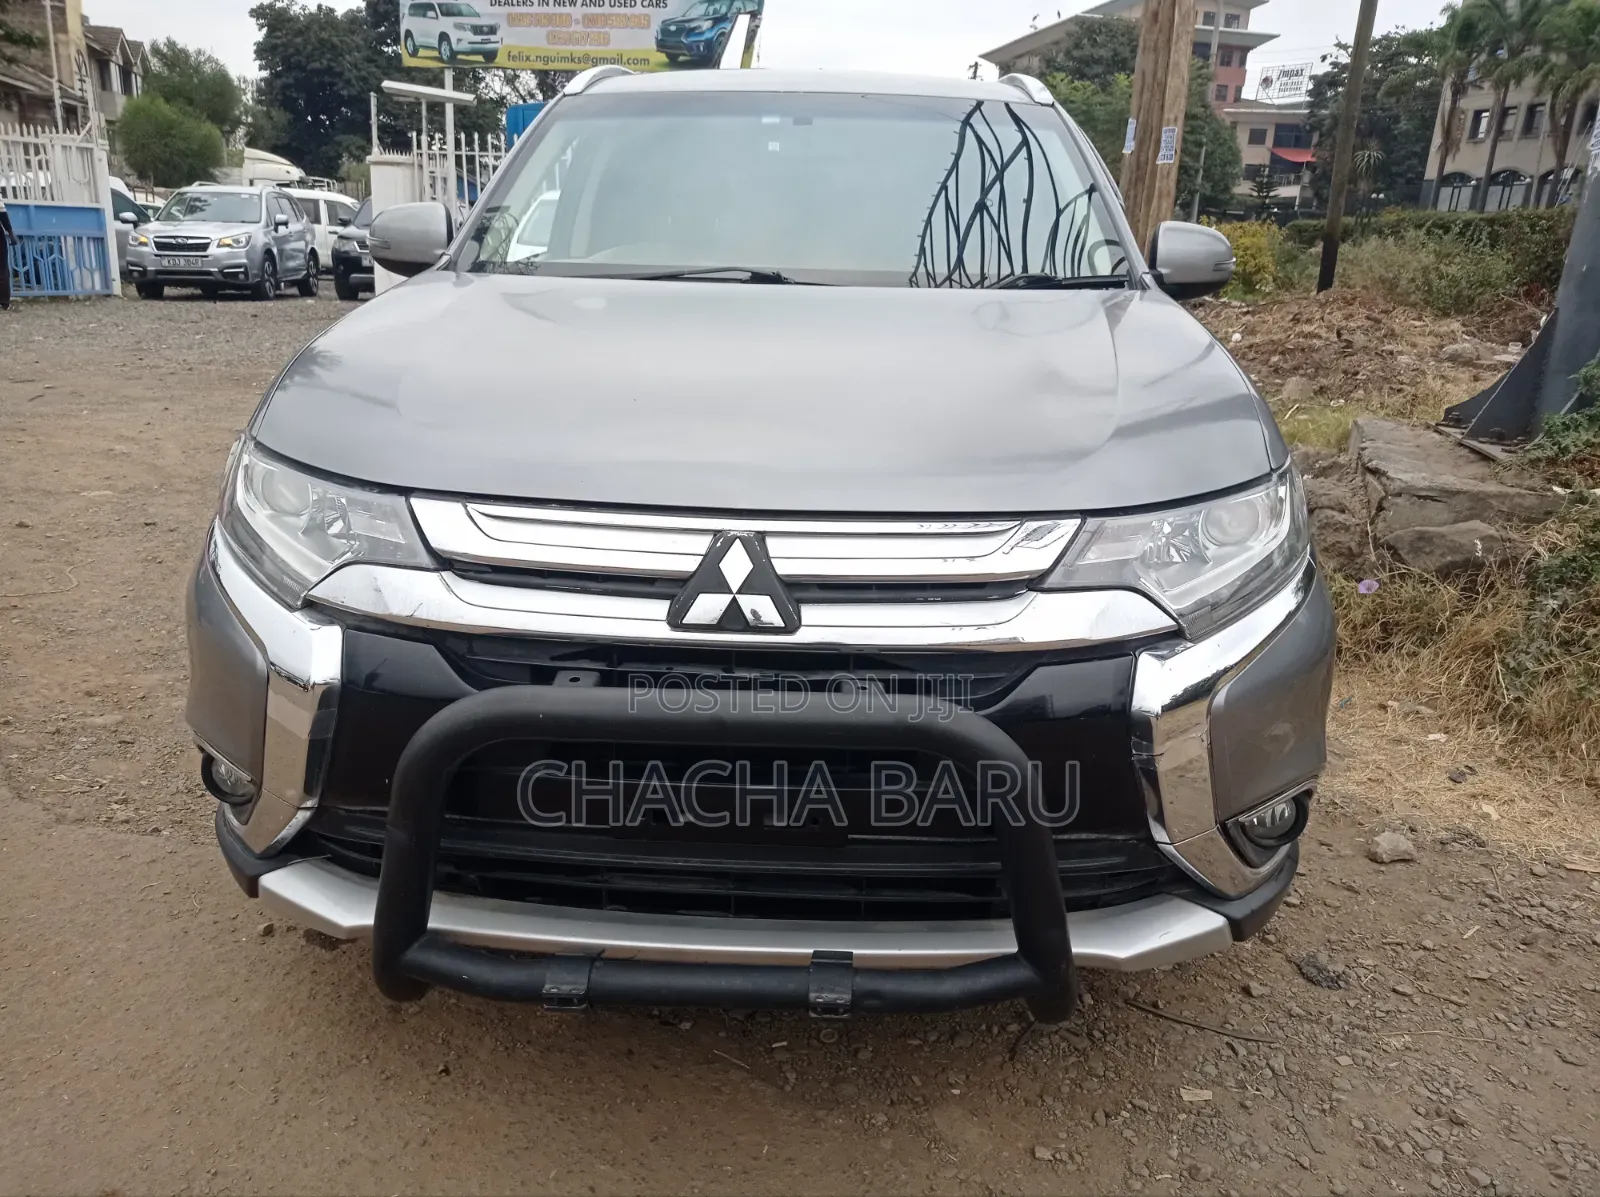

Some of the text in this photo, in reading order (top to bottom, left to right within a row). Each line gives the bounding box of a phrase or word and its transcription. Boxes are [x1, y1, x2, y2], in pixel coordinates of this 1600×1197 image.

[553, 0, 577, 8] NEW
[580, 0, 605, 8] AND
[609, 0, 637, 8] USED
[641, 0, 668, 9] CARS
[507, 50, 650, 67] felix.nguimks@gmail.com
